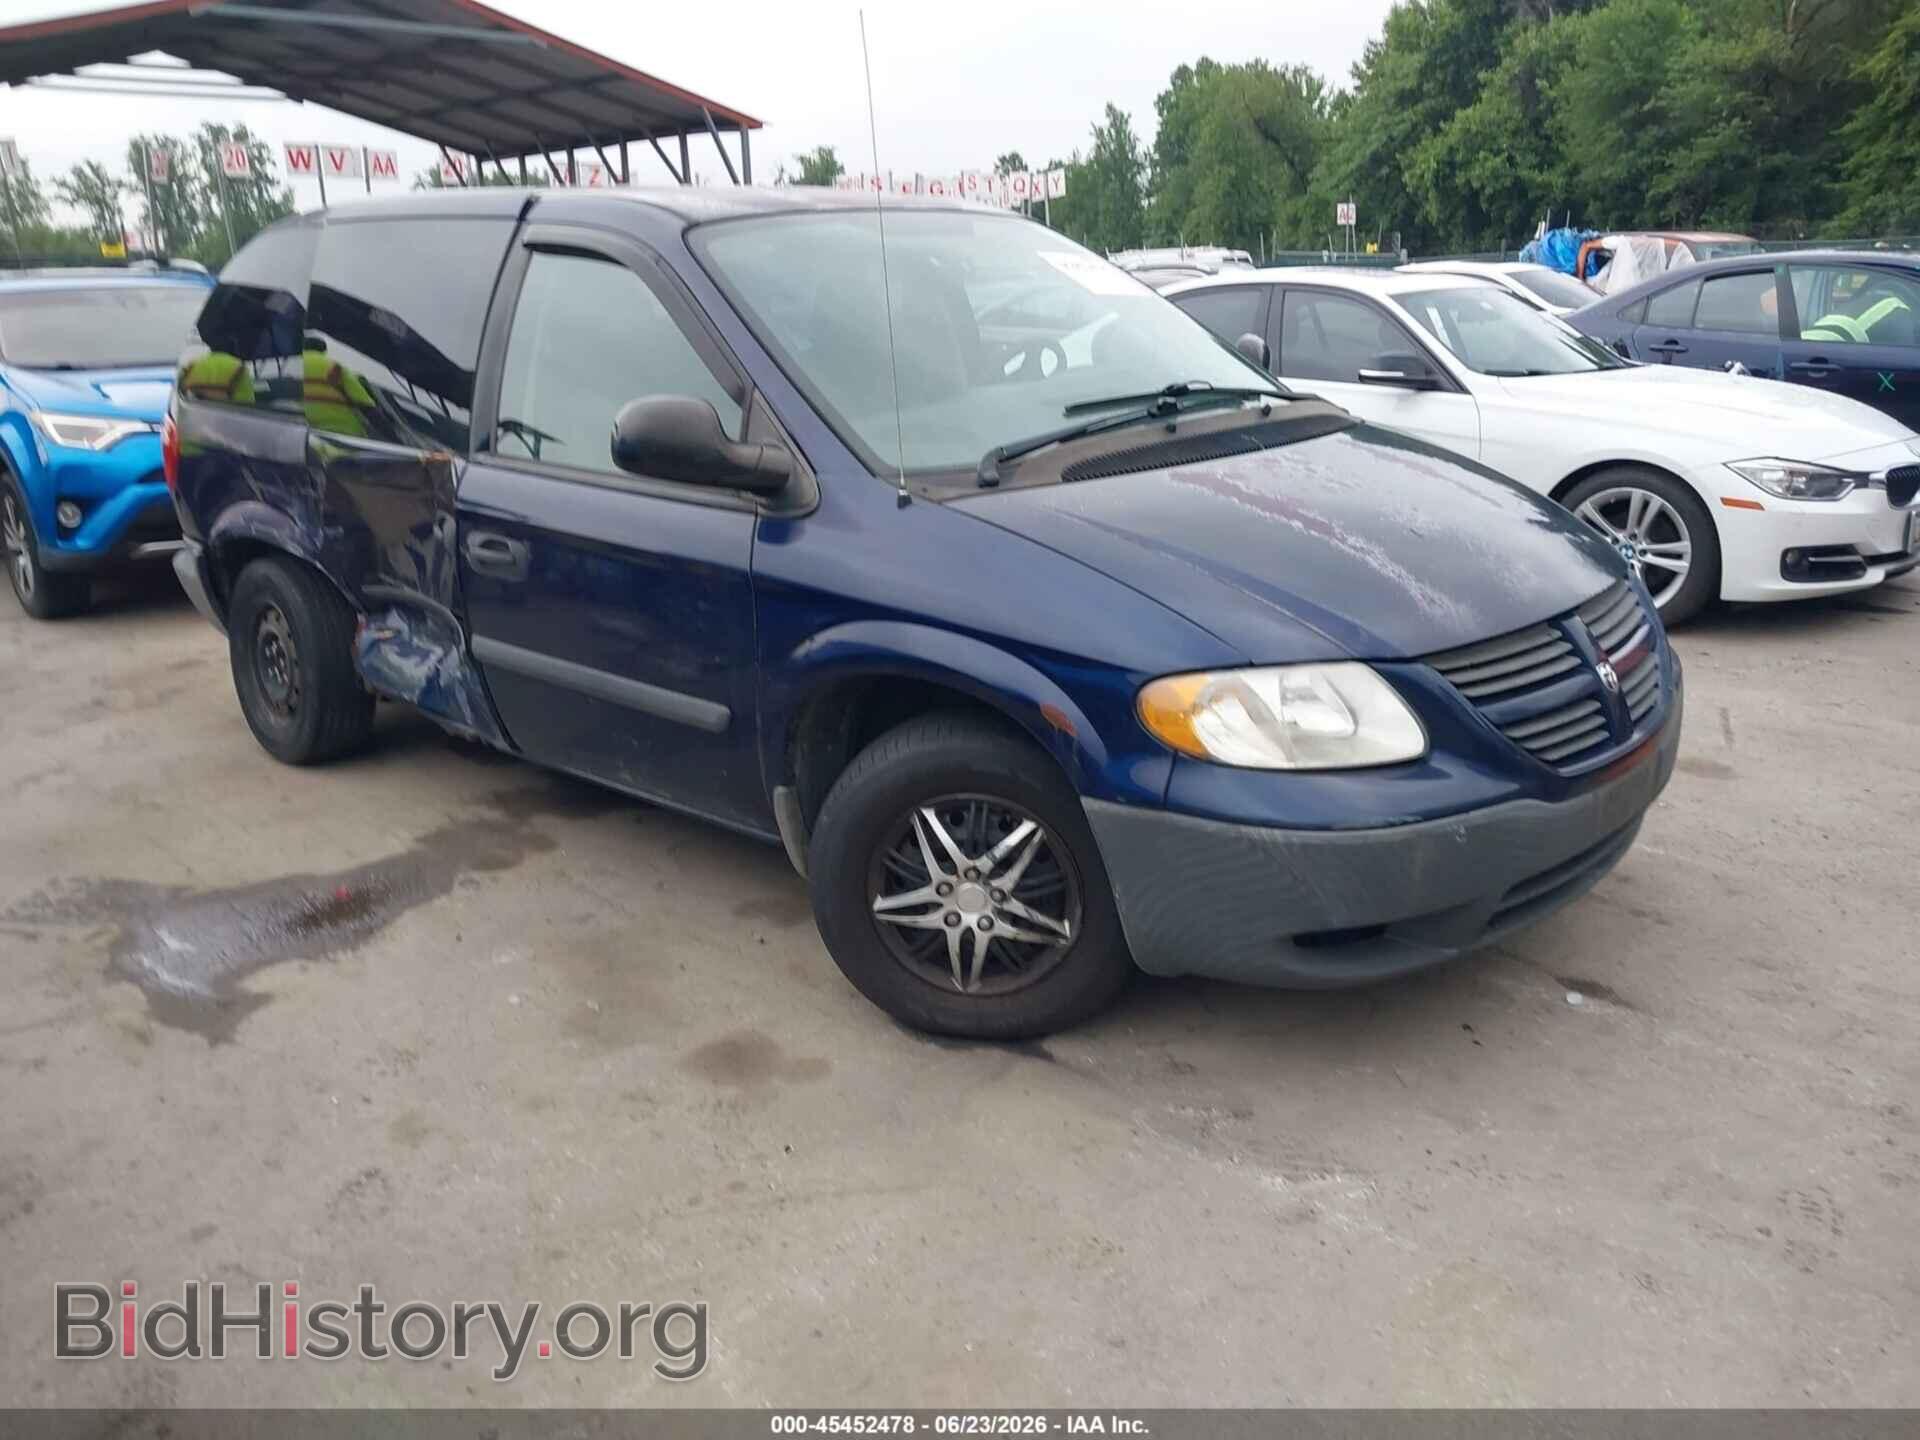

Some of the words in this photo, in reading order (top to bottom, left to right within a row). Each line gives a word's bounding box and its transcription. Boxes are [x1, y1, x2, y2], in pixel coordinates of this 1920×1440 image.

[225, 149, 247, 168] 20
[288, 149, 311, 171] W
[329, 151, 345, 172] V
[1051, 176, 1061, 190] Y
